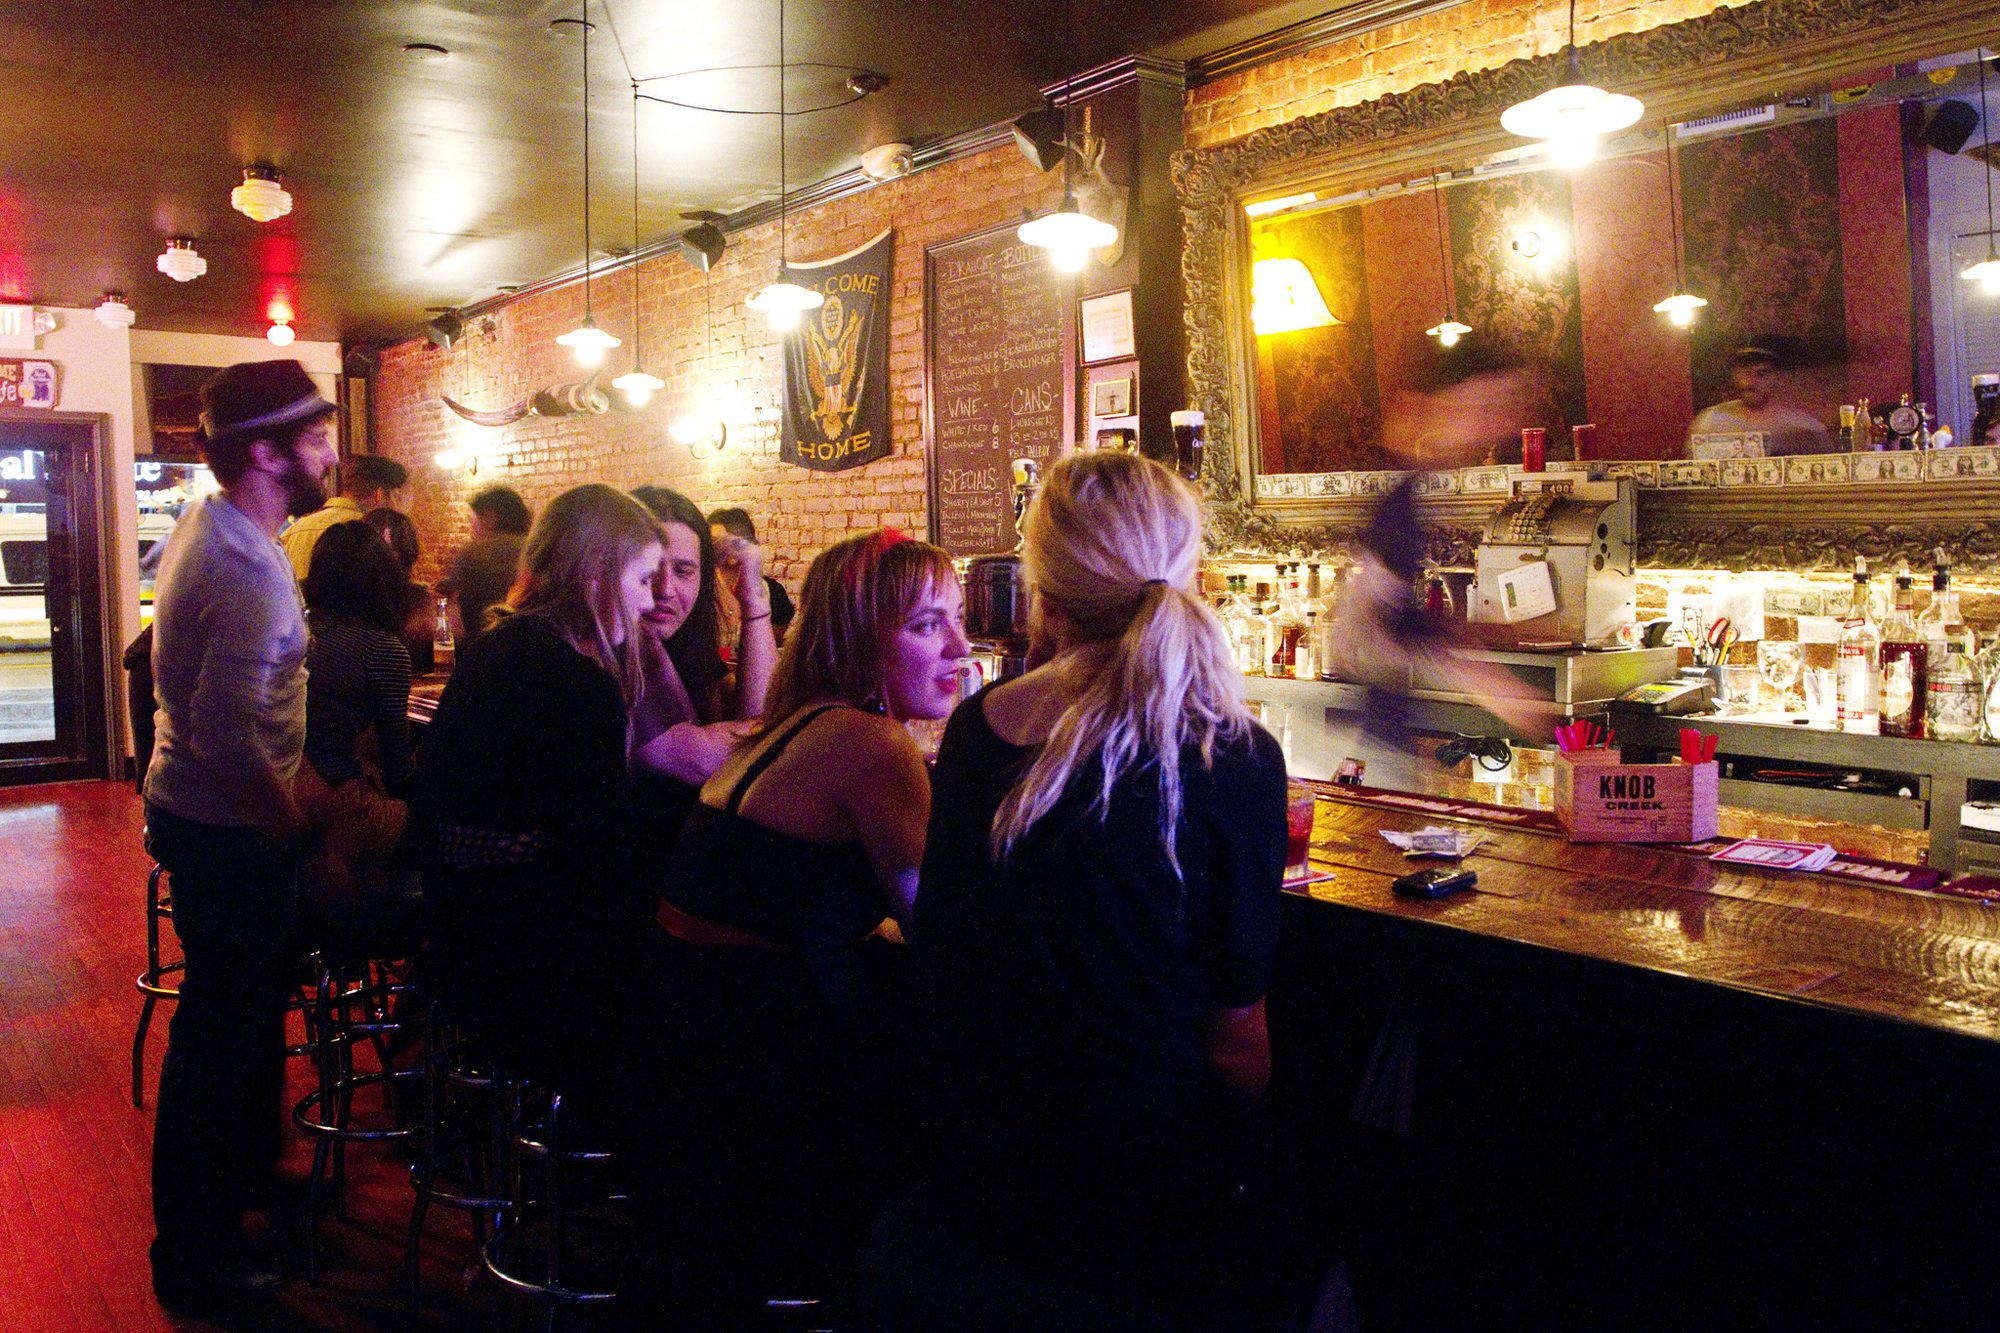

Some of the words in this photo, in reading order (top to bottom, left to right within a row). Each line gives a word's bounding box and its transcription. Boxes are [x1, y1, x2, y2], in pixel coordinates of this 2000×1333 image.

[947, 396, 982, 418] WINE
[1010, 380, 1052, 415] CANS
[991, 418, 999, 434] 6
[797, 431, 871, 461] HOME
[991, 436, 999, 450] 8
[942, 467, 998, 495] SPECIALS
[995, 492, 1002, 507] 5
[1600, 775, 1655, 799] KNOB
